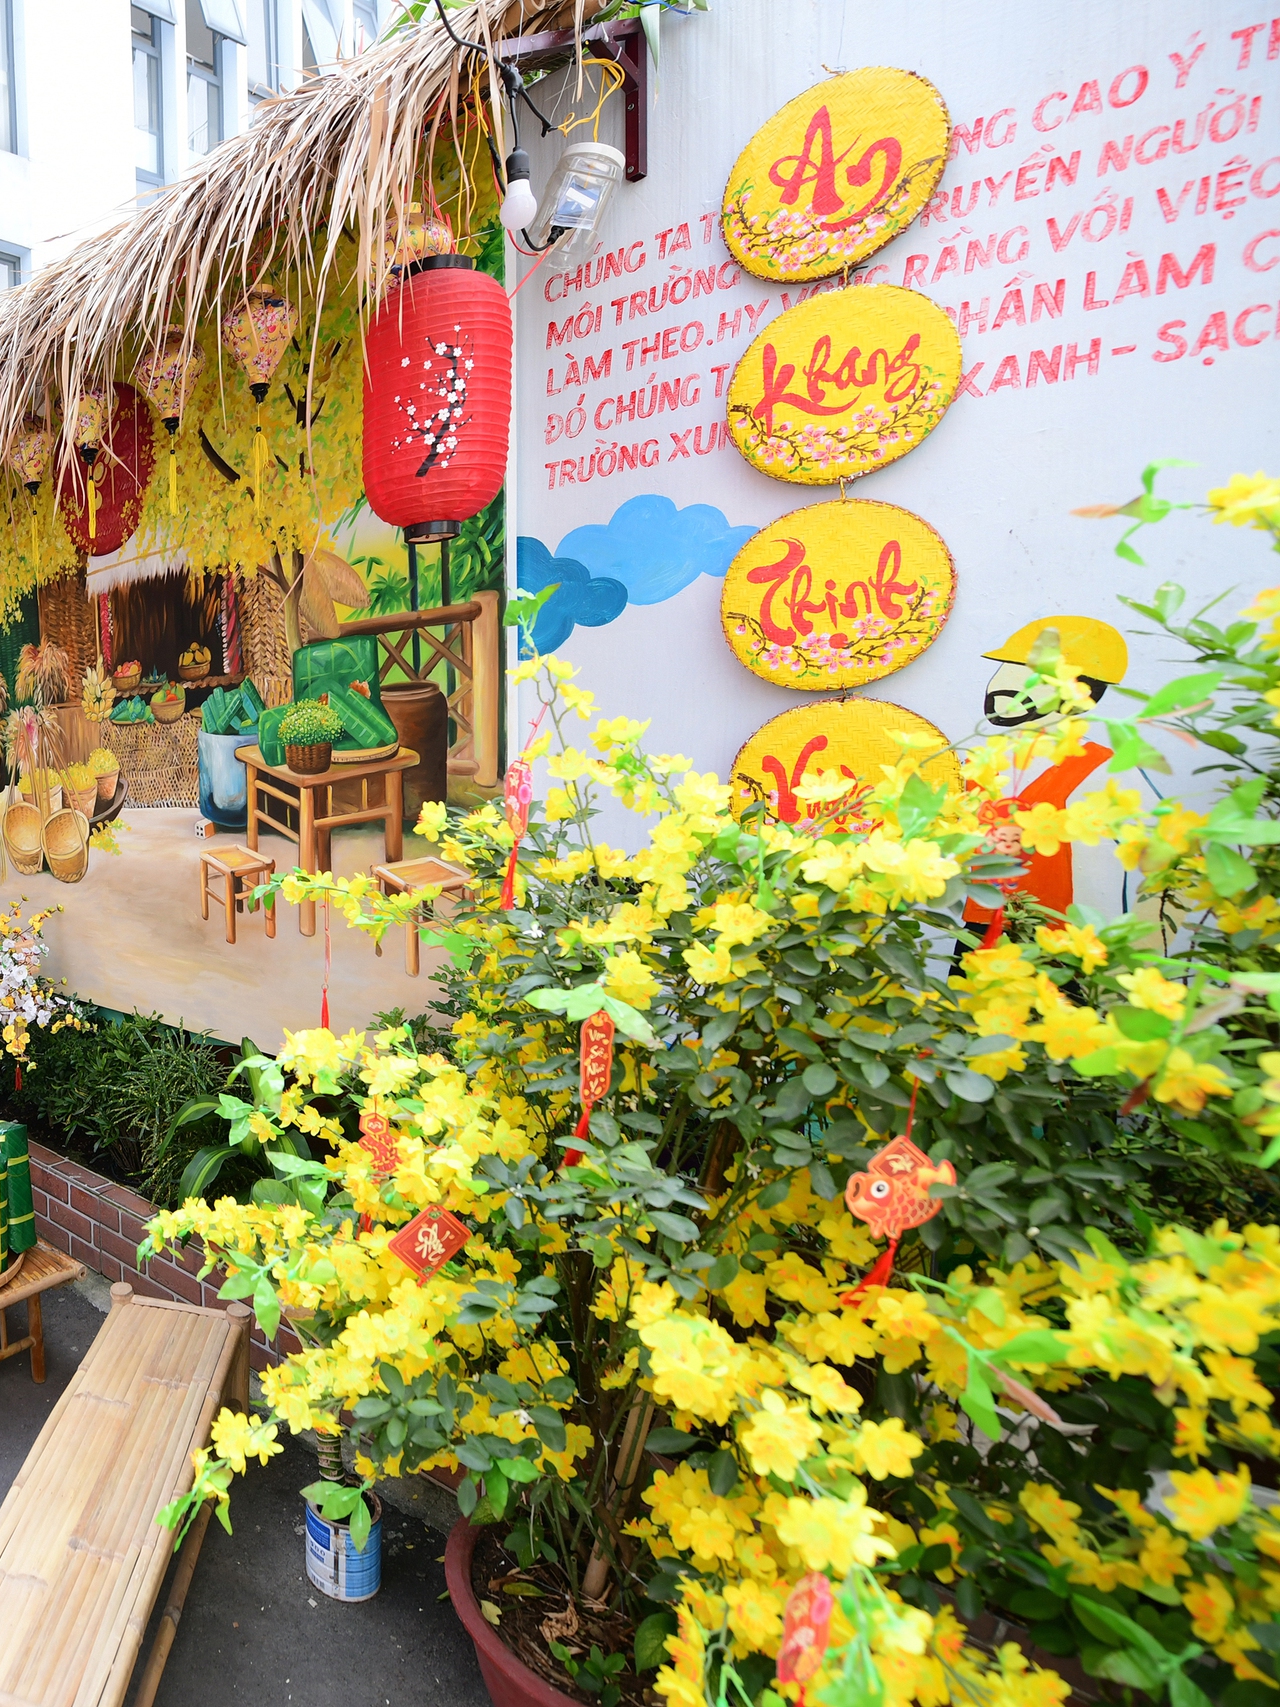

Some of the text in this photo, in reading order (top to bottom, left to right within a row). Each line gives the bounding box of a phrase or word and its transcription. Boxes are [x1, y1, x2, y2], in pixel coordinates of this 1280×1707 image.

[544, 241, 646, 302] CHÚNG
[654, 222, 692, 260] TA
[946, 108, 1017, 162] NG
[1031, 64, 1149, 133] CAO
[1169, 30, 1207, 89] Ý
[545, 86, 1263, 350] MÔI TRƯỜNG RUYỀN NGƯỜI
[768, 104, 903, 232] An
[545, 393, 587, 446] ĐÓ
[593, 372, 701, 431] CHÚNG
[1082, 241, 1217, 312] LÀM
[546, 347, 614, 398] LÀM
[1046, 186, 1135, 254] VỚI
[752, 333, 921, 438] Khang
[544, 438, 660, 490] TRƯỜNG
[1151, 302, 1280, 367] SẠC
[746, 536, 919, 649] Thịnh
